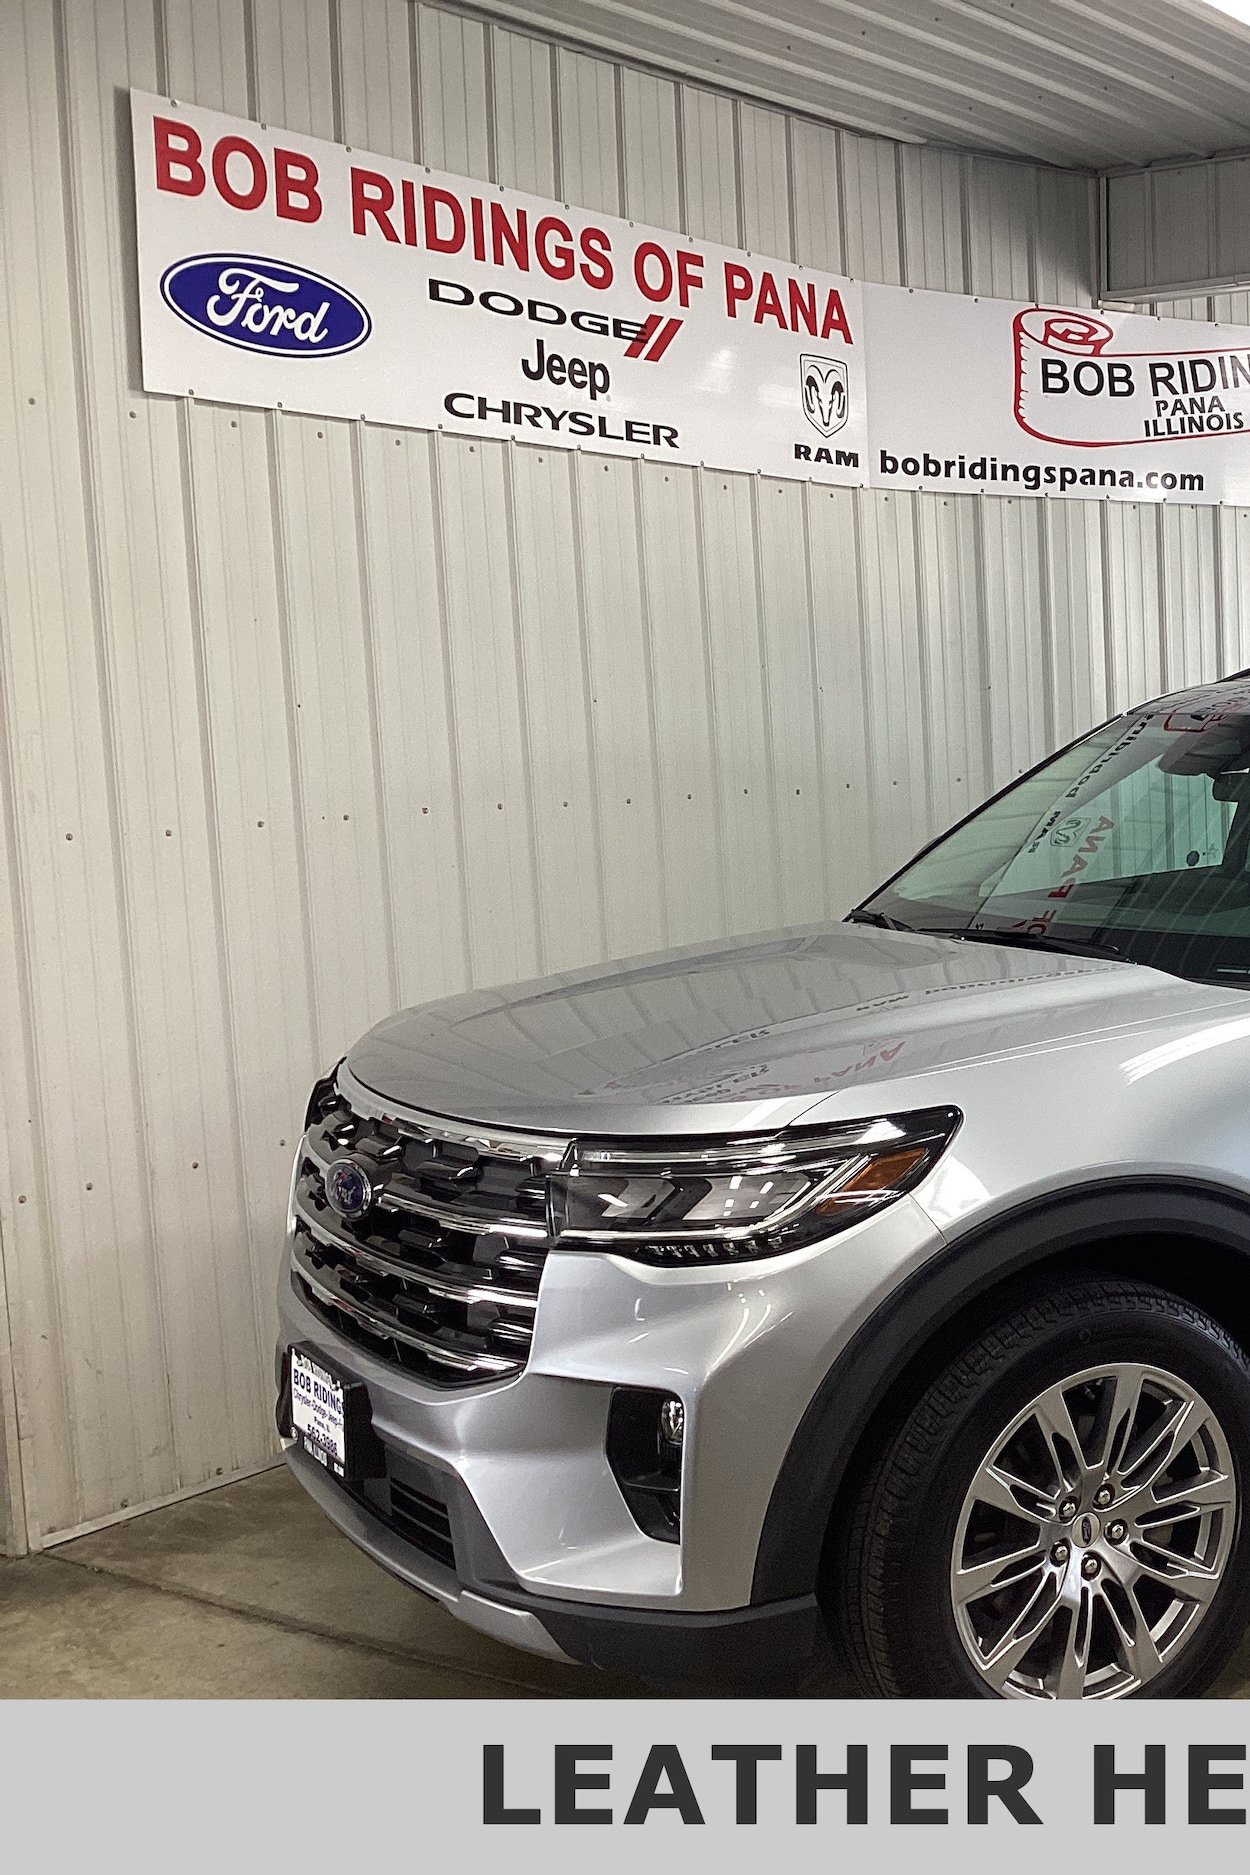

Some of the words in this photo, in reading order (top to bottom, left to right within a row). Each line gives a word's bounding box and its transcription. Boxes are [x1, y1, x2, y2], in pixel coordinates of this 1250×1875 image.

[153, 117, 322, 224] BOB
[351, 166, 614, 290] RIDINGS
[633, 241, 704, 308] OF
[724, 262, 854, 344] PANA
[206, 267, 330, 343] Ford
[428, 278, 649, 344] DODGE
[521, 338, 611, 401] Jeep
[1041, 358, 1135, 397] BOB
[443, 392, 680, 449] CHRYSLER
[1143, 411, 1245, 438] ILLINOIS
[1155, 396, 1226, 417] PANA
[794, 443, 860, 468] RAM
[880, 449, 1205, 493] bobridingspana.com
[293, 1368, 312, 1394] BOB
[313, 1380, 343, 1415] RIDING
